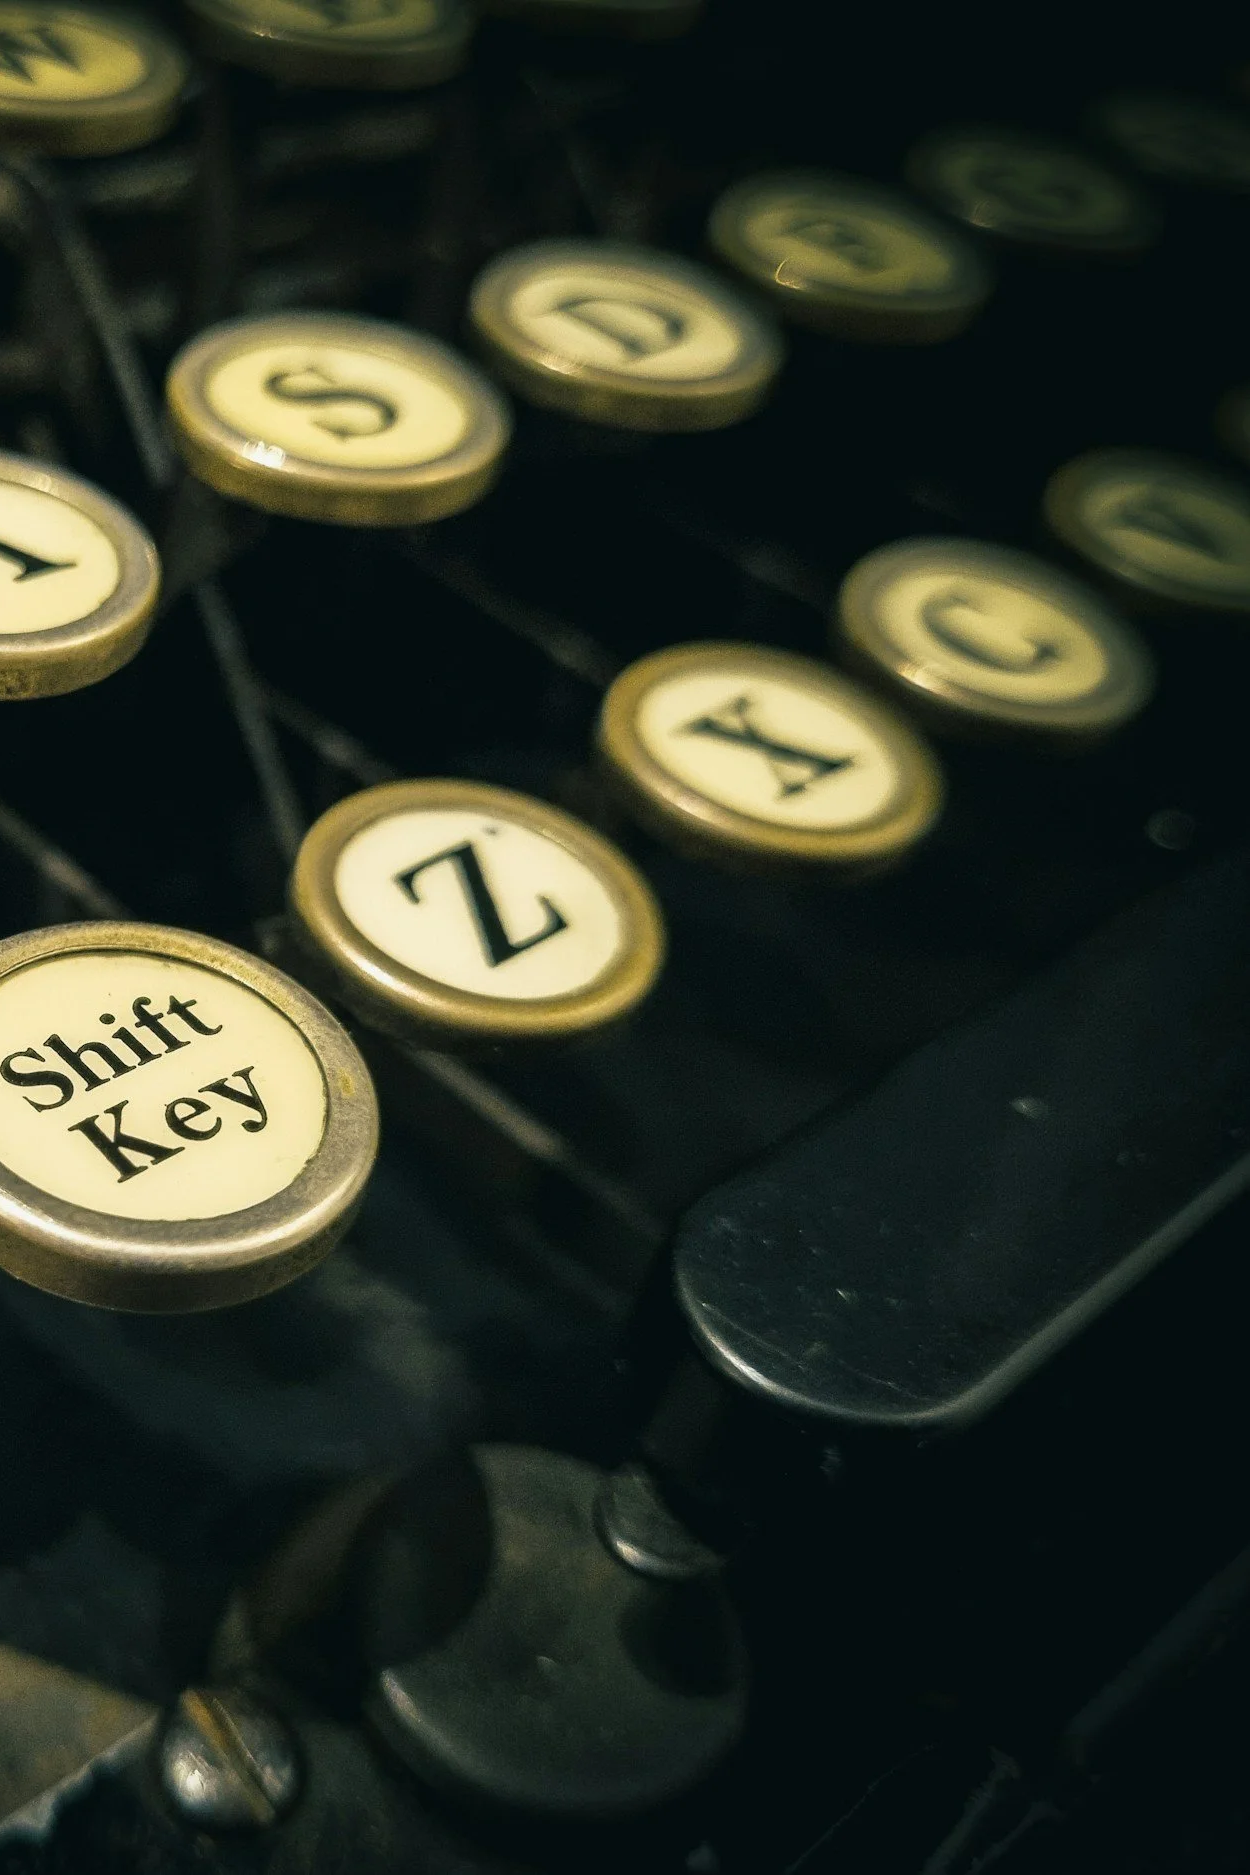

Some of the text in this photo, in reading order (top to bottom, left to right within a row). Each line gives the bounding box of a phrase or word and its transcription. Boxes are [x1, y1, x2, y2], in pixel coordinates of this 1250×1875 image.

[535, 294, 687, 364] D
[262, 364, 400, 442] S
[918, 587, 1062, 675] C
[672, 692, 856, 802] X
[393, 839, 569, 968] Z
[0, 994, 223, 1113] Shift
[67, 1065, 269, 1184] Key
